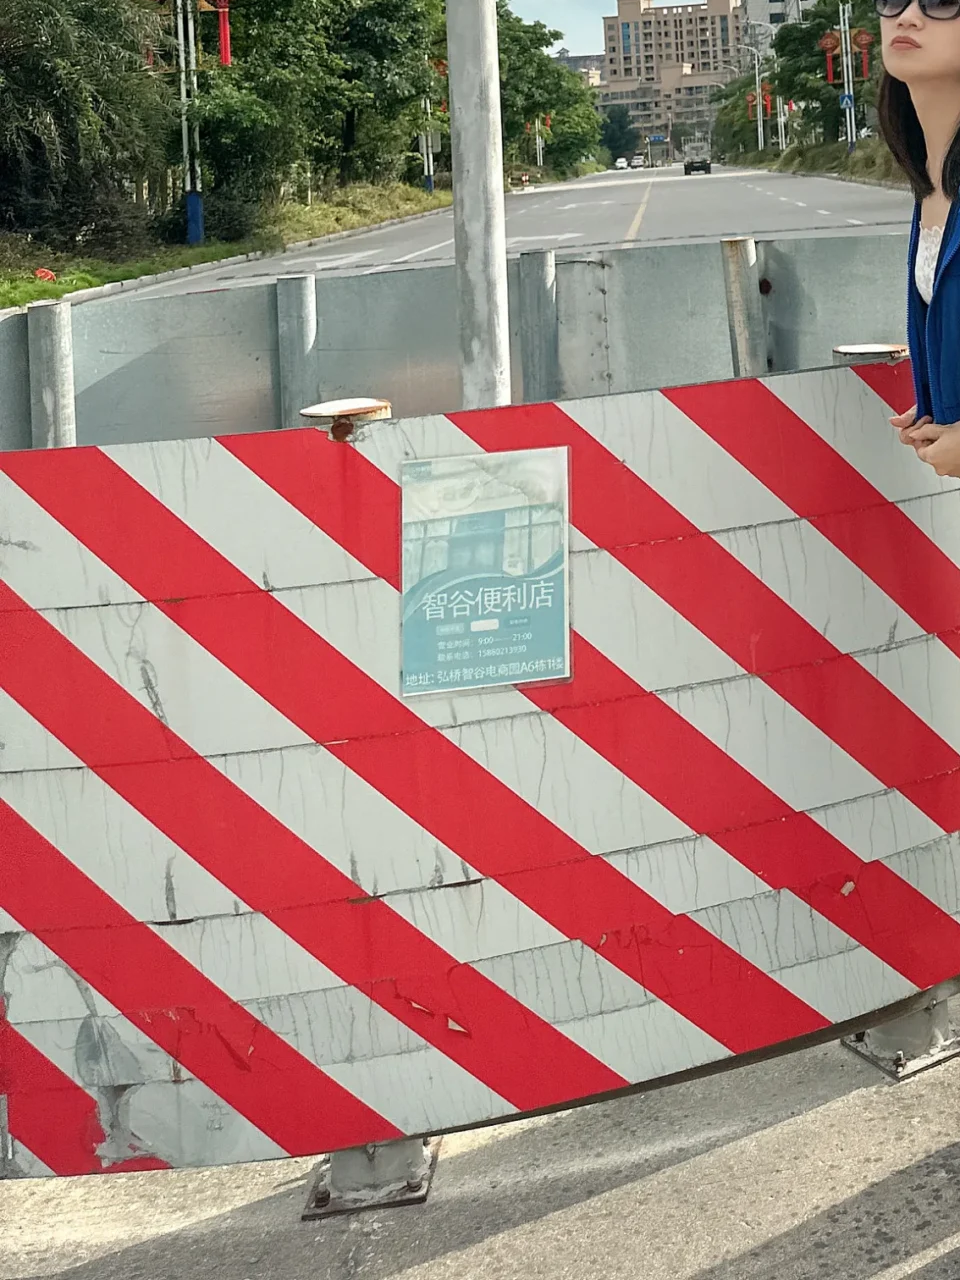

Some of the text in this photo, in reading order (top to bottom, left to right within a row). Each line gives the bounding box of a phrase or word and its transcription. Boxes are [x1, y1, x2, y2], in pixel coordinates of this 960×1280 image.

[422, 580, 555, 621] 智谷便利店
